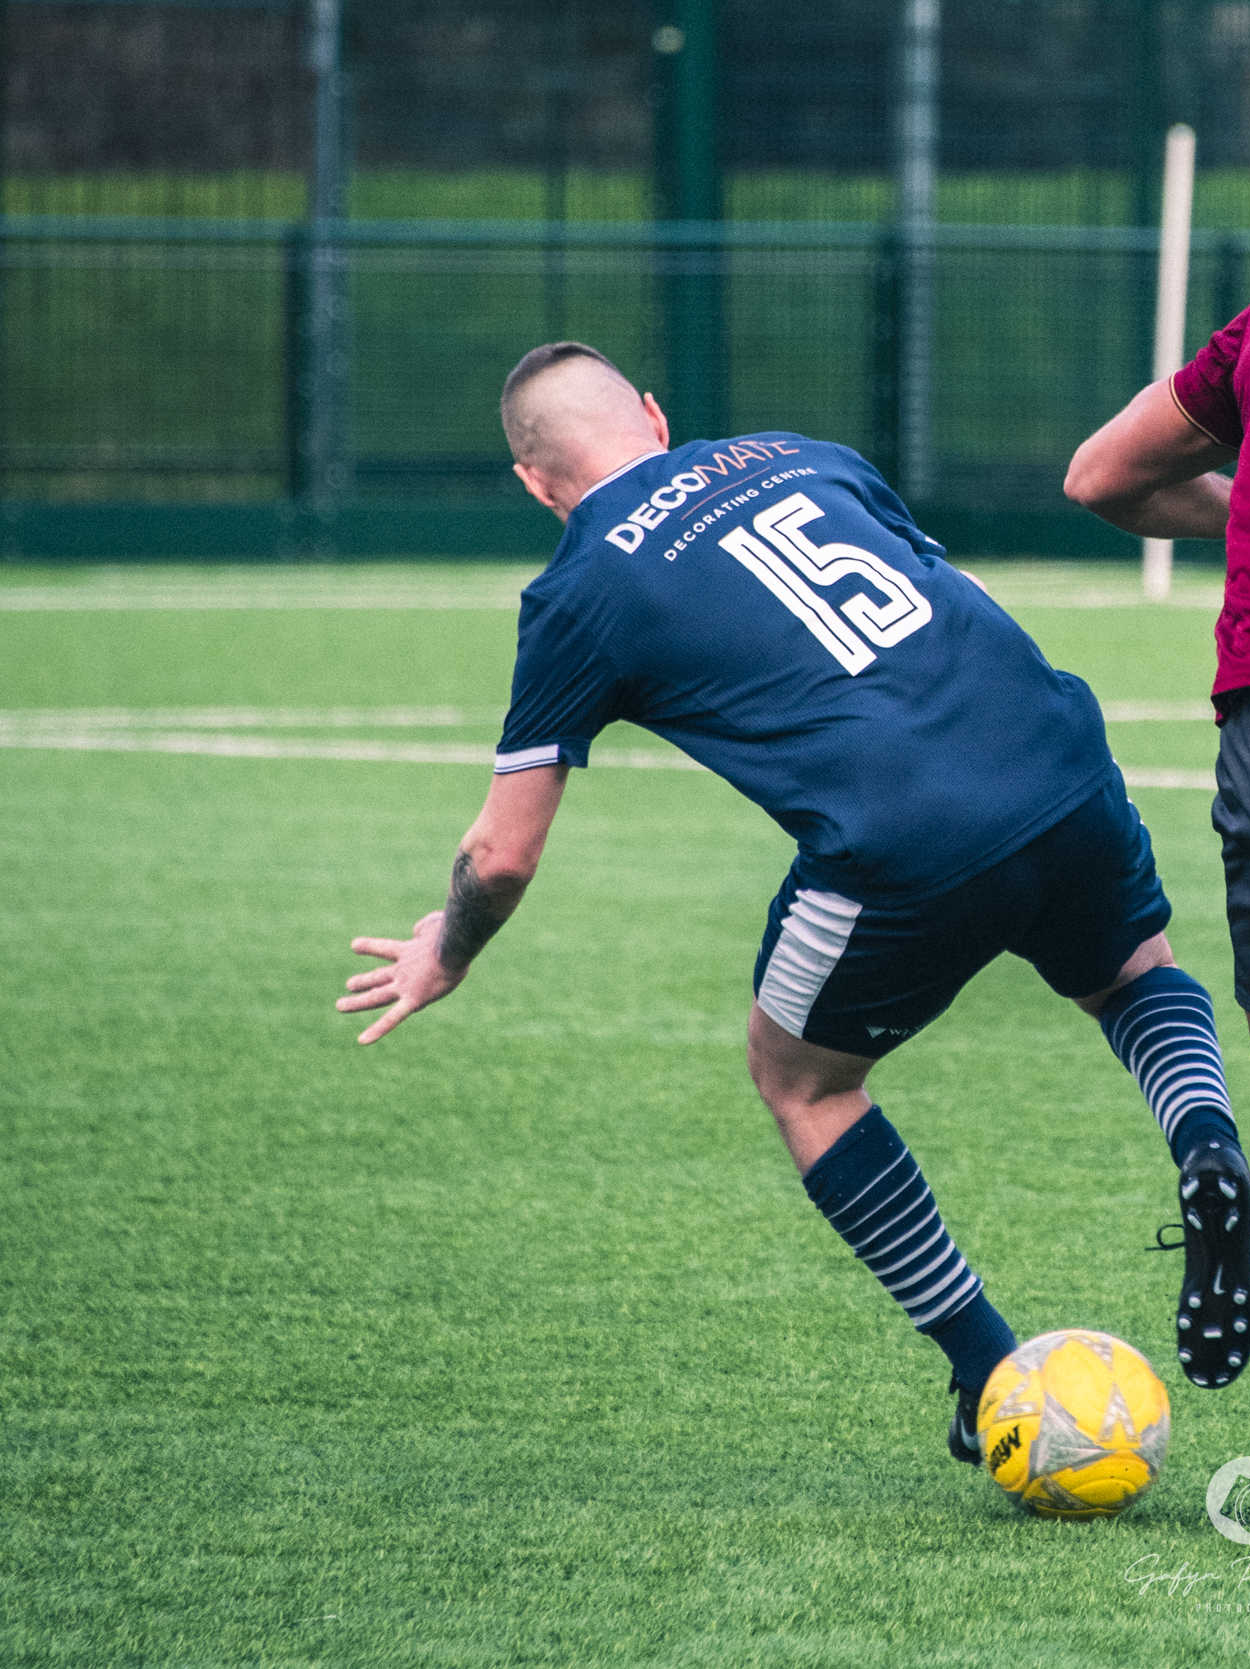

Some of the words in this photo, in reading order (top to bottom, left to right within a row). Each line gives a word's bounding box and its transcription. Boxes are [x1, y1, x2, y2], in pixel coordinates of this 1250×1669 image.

[604, 440, 800, 554] DECOMATE
[663, 486, 760, 561] DECORATING
[761, 466, 817, 488] CENTRE
[718, 491, 933, 677] 15
